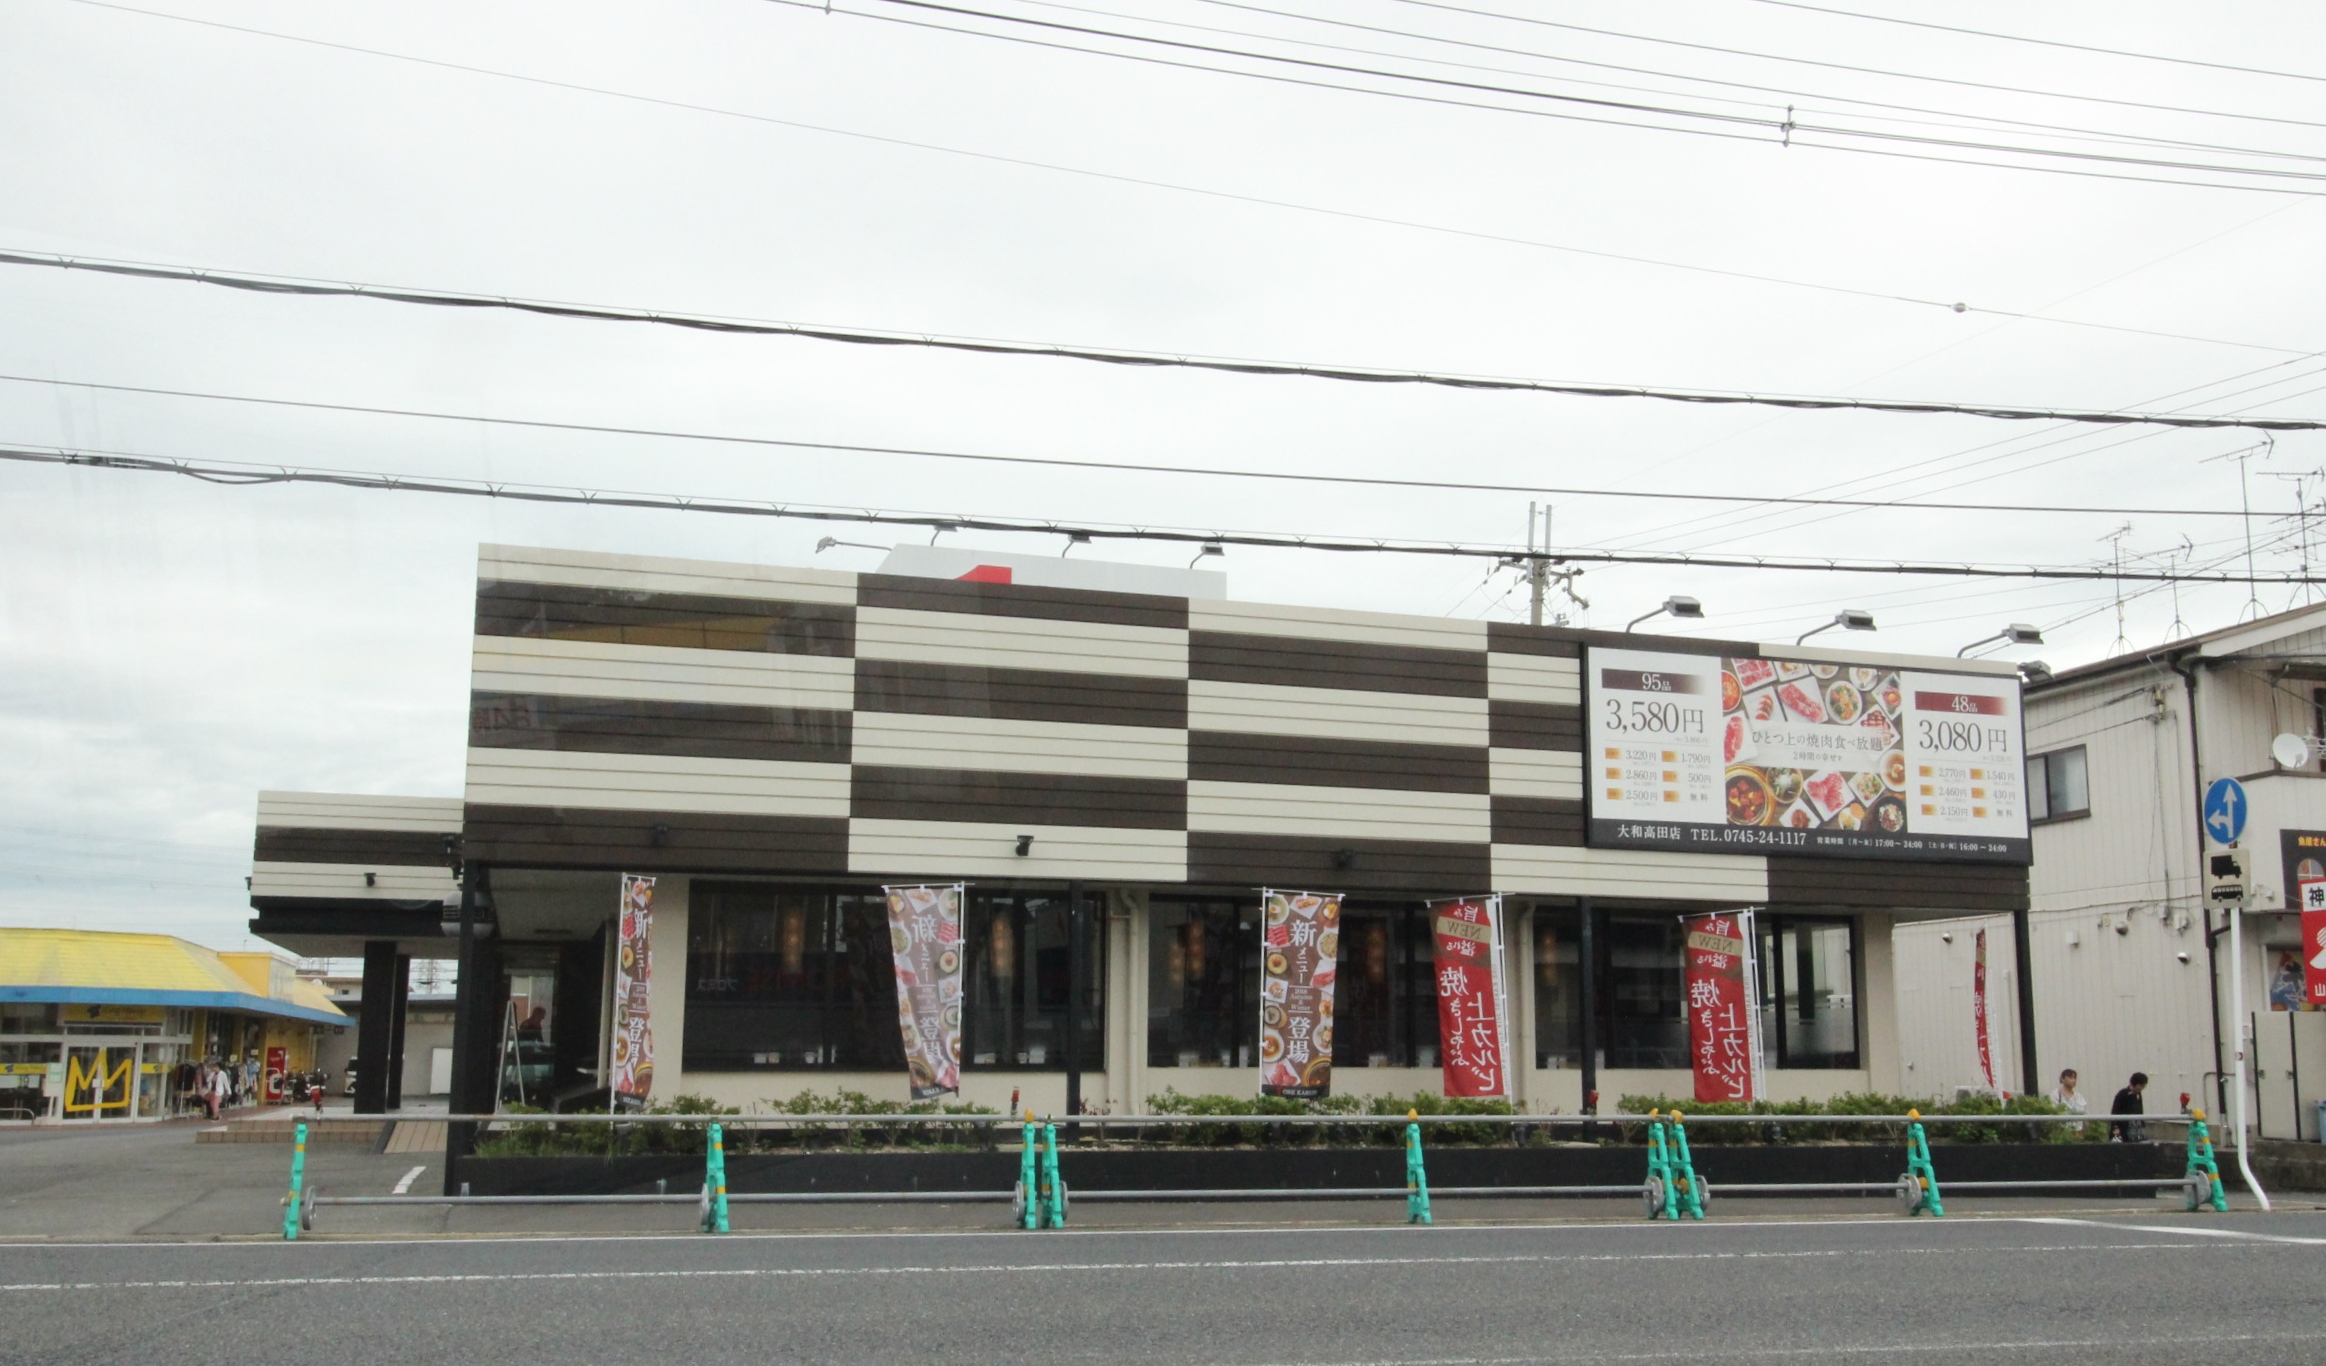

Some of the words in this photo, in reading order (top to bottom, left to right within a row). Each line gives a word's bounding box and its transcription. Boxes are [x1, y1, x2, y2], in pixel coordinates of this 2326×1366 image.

[1641, 673, 1672, 692] 95品
[1951, 695, 1978, 713] 48品
[1606, 698, 1703, 734] 3,580円
[1752, 730, 1883, 752] ひとつ上の焼肉食べ放題
[1919, 719, 2007, 753] 3,080円
[1617, 824, 1681, 840] 大和高田店
[2309, 886, 2325, 907] 神
[1289, 919, 1317, 984] 新メニュー
[1287, 1016, 1311, 1063] 登場
